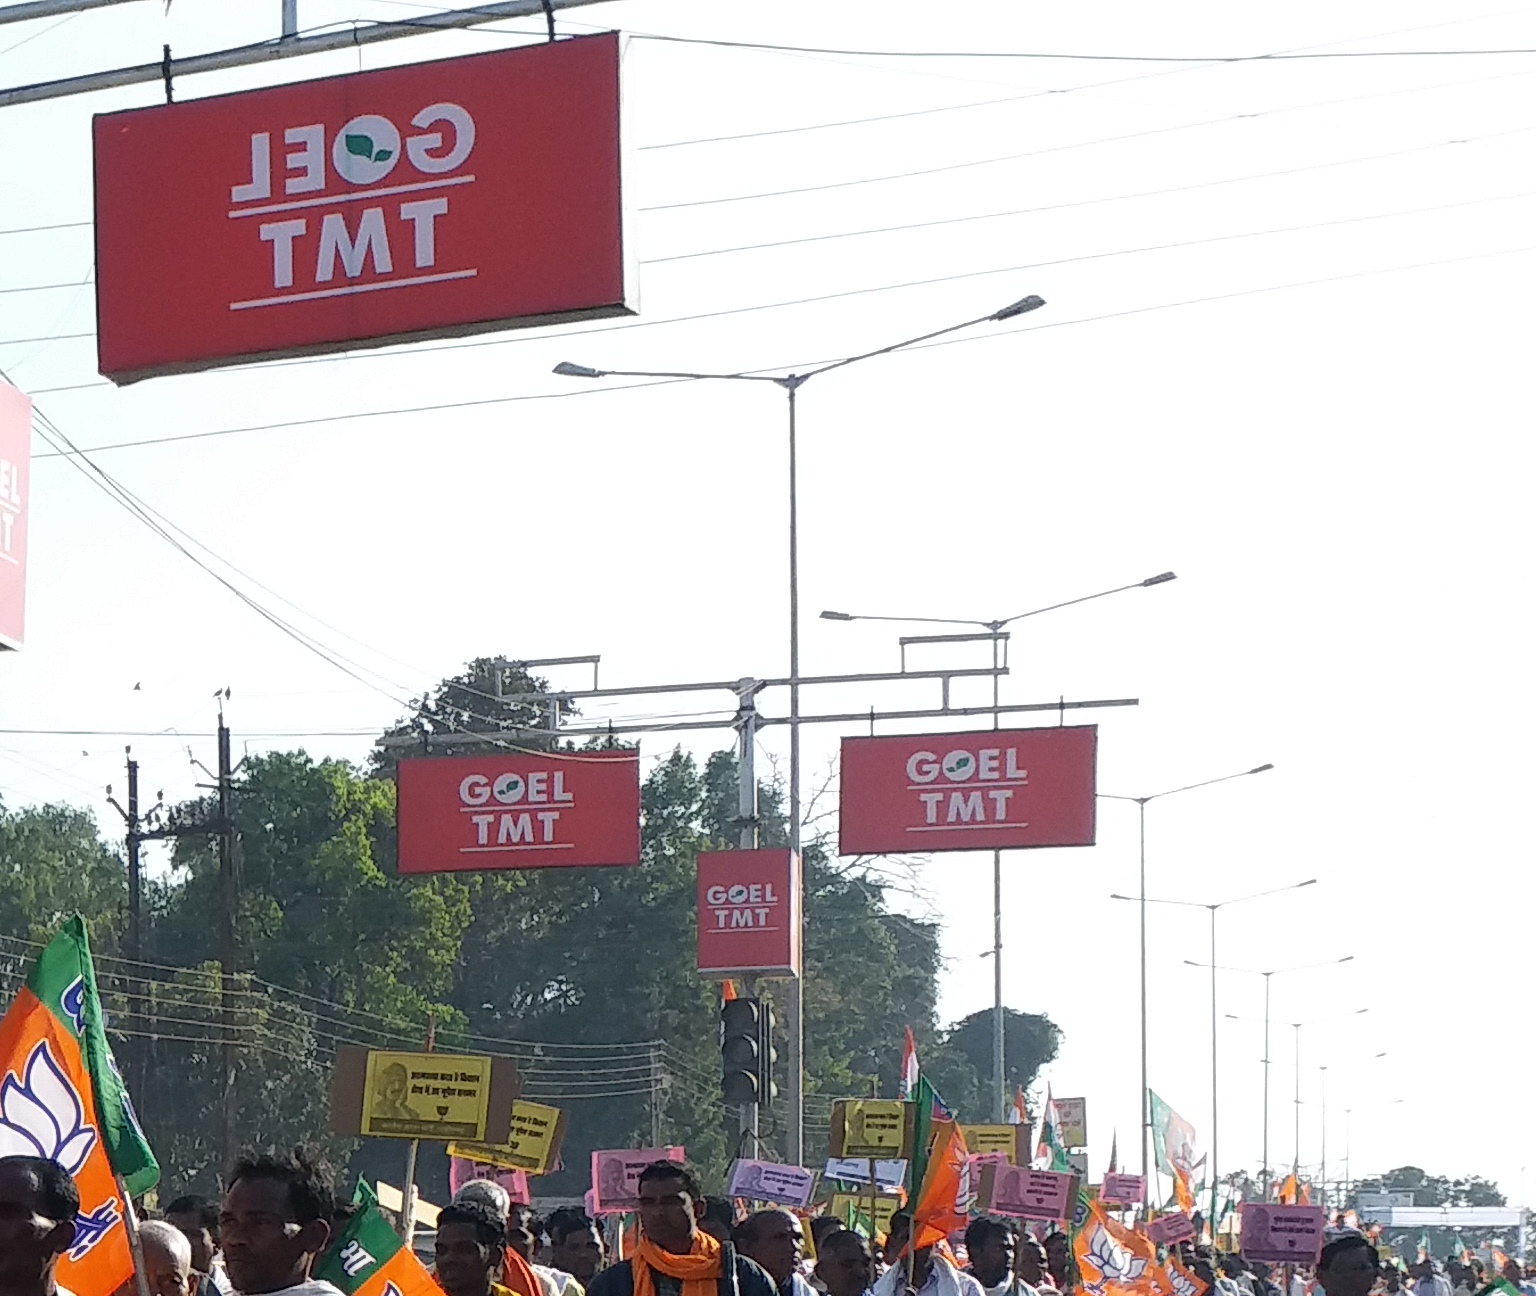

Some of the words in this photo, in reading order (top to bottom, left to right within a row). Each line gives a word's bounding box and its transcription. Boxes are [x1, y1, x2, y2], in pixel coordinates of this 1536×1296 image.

[907, 748, 1027, 784] GOEL
[460, 771, 573, 806] GOEL
[920, 789, 1014, 825] TMT
[472, 811, 560, 845] TMT
[707, 882, 778, 905] GOEL
[714, 906, 770, 929] TMT
